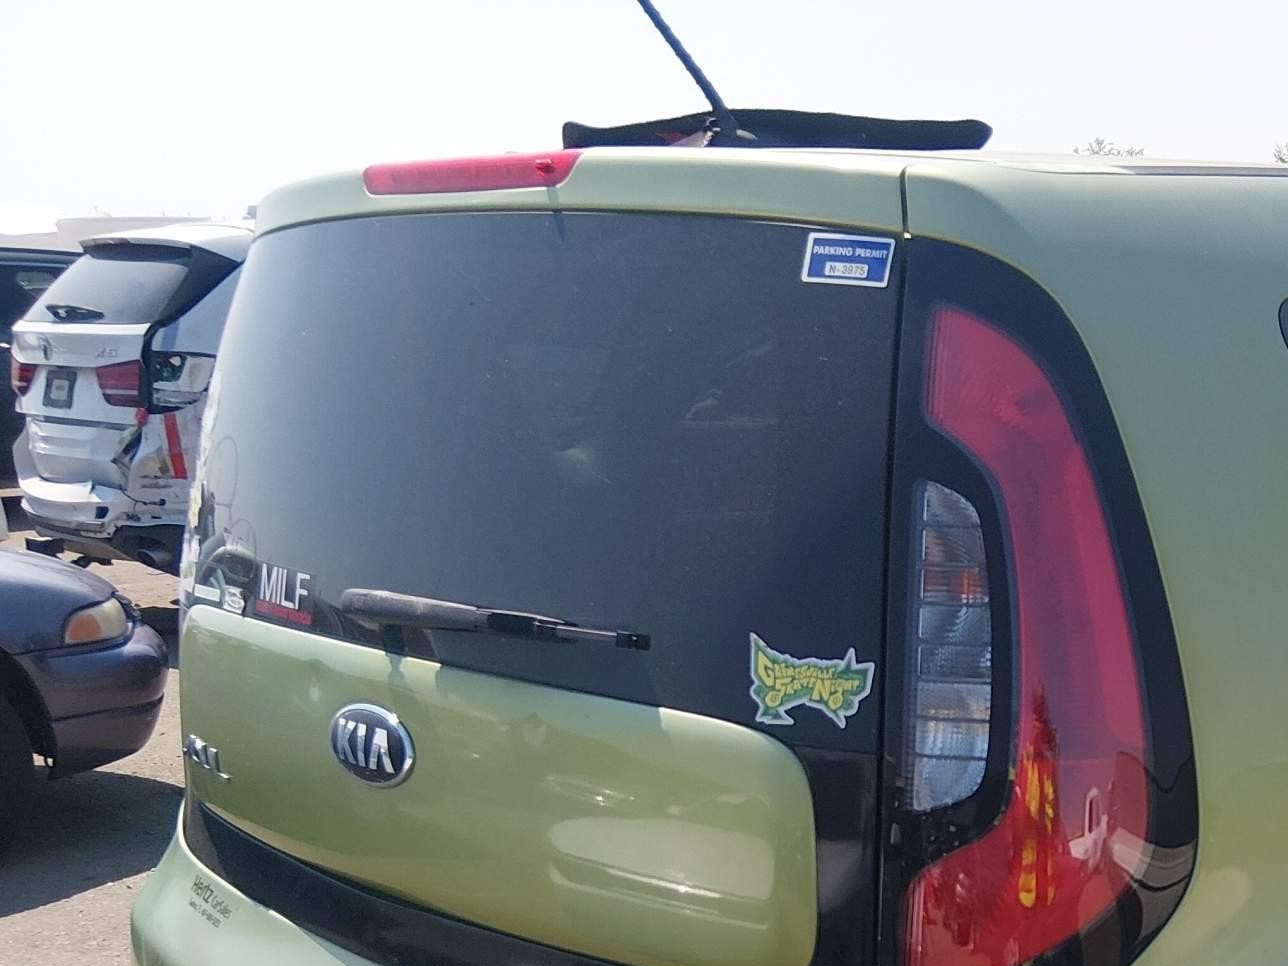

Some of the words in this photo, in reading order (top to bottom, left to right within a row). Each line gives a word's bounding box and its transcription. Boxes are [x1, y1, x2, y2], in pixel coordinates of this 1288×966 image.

[813, 245, 853, 256] PARKING
[855, 248, 887, 259] PERMIT
[829, 264, 865, 276] N-3975
[260, 562, 310, 610] MILF
[337, 717, 396, 775] KIA
